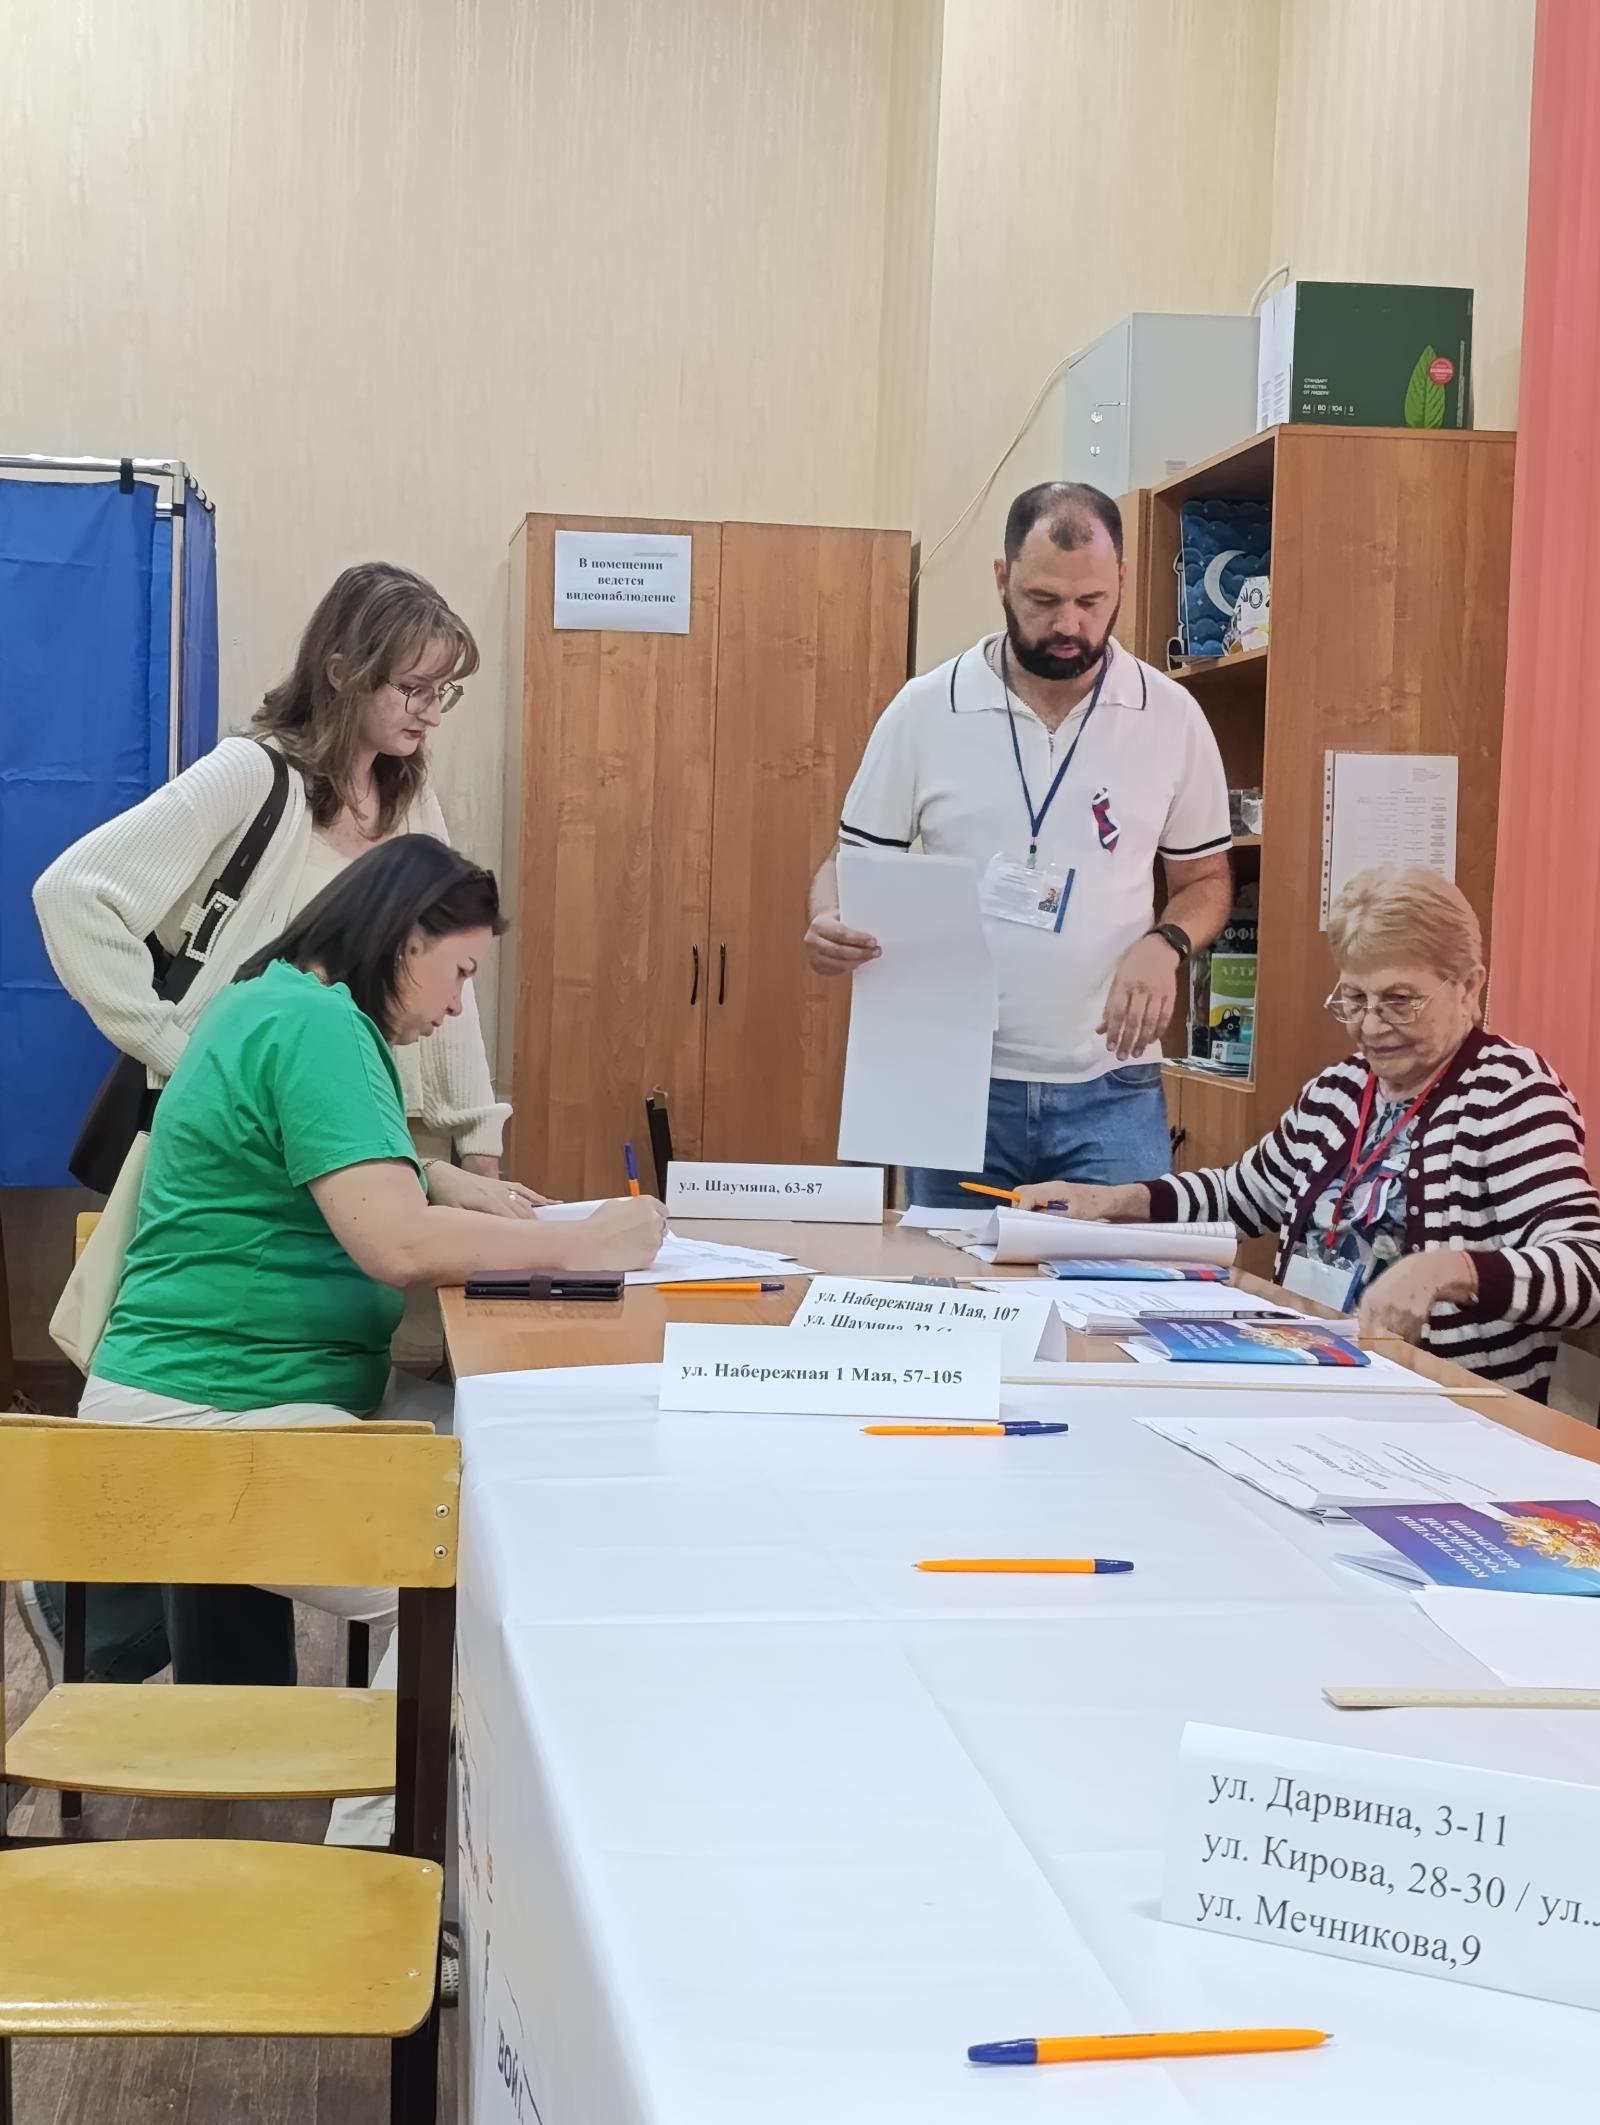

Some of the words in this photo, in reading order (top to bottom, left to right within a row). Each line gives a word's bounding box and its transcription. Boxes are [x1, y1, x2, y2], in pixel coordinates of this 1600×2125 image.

[579, 557, 588, 568] В
[591, 560, 663, 571] помещении
[566, 591, 676, 603] видеонаблюдение
[598, 576, 644, 586] ведется
[679, 1180, 700, 1194] ул.
[705, 1179, 780, 1195] Шаумяна,
[784, 1182, 823, 1195] 63-87
[803, 1314, 826, 1328] ул.
[815, 1290, 837, 1305] ул.
[842, 1290, 933, 1314] Набережная
[938, 1302, 946, 1314] 1
[949, 1303, 987, 1320] Мая,
[992, 1306, 1020, 1322] 107
[681, 1364, 708, 1381] ул.
[715, 1363, 829, 1382] Набережная
[837, 1367, 843, 1381] 1
[851, 1367, 897, 1384] Мая,
[903, 1369, 963, 1384] 57-105
[1396, 1515, 1488, 1579] КОНСТИТУЦИЯ
[1420, 1517, 1506, 1574] РОССИЙСКОЙ
[1446, 1520, 1521, 1569] ФЕДЕРАЦИИ
[1208, 1773, 1255, 1803] ул.
[1266, 1776, 1423, 1837] Дарвина,
[1434, 1805, 1508, 1847] 3-11
[1201, 1832, 1248, 1863] ул.
[1261, 1835, 1395, 1895] Кирова,
[1407, 1863, 1505, 1908] 28-30
[1537, 1895, 1600, 1926] ул.
[1197, 1891, 1241, 1922] ул.
[1254, 1895, 1482, 1970] Мечникова,9
